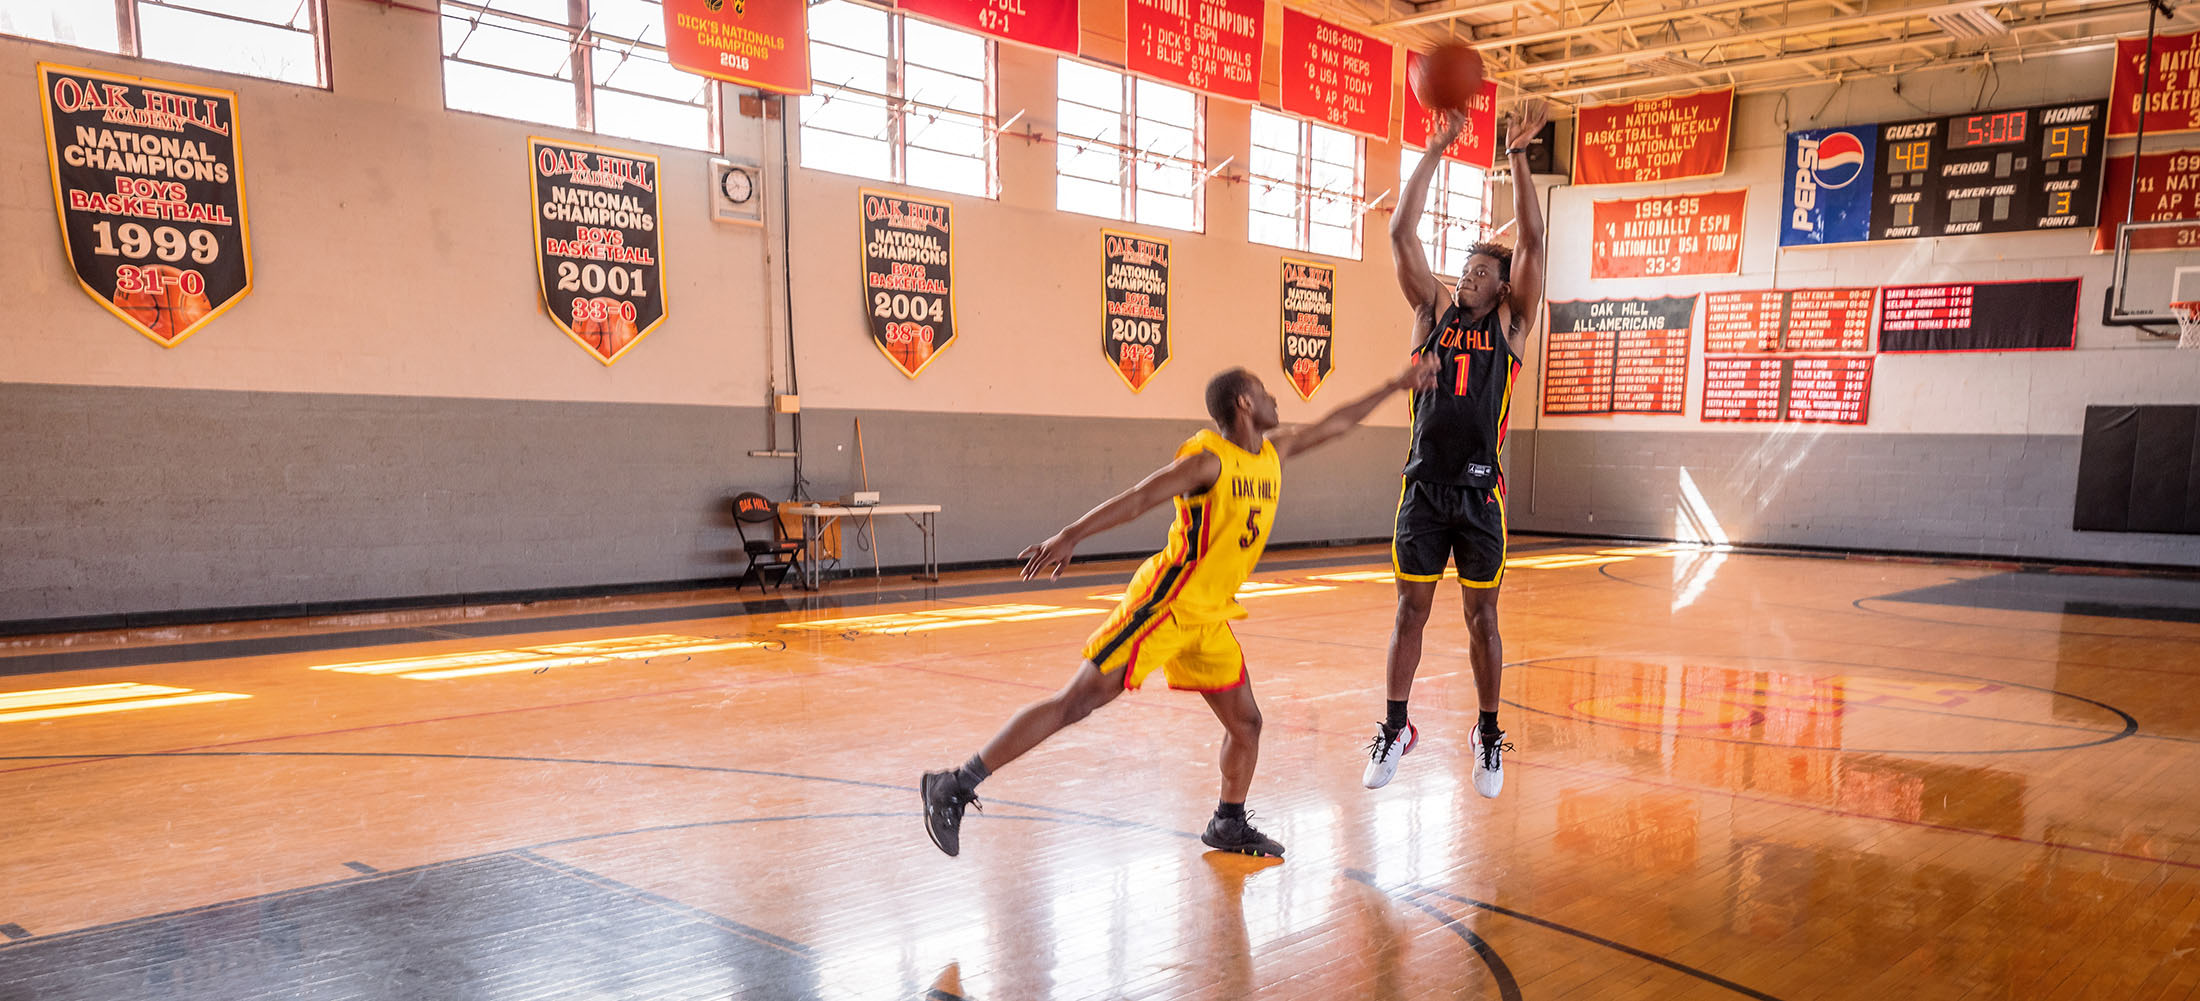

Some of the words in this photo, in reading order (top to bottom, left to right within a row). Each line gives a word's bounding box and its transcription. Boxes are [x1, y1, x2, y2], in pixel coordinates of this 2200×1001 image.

[677, 13, 719, 34] DICK'S
[722, 24, 785, 50] NATIONALS
[979, 8, 1009, 33] 47-1
[1200, 3, 1255, 38] CHAMPIONS
[1194, 23, 1218, 44] ESPN
[1316, 24, 1363, 54] 2016-2017
[698, 32, 769, 60] CHAMPIONS
[1158, 28, 1191, 52] DICK'S
[1198, 41, 1251, 68] NATIONALS
[720, 52, 749, 71] 2016
[1157, 45, 1184, 66] BLUE
[1191, 55, 1217, 75] STAR
[1223, 64, 1252, 82] MEDIA
[1321, 48, 1339, 68] MAX
[1343, 54, 1370, 77] PREPS
[1188, 71, 1209, 88] 45-1
[1320, 67, 1338, 87] USA
[1344, 75, 1373, 96] TODAY
[55, 77, 134, 113] OAK
[142, 90, 229, 136] HILL
[1325, 90, 1338, 104] AP
[1343, 94, 1366, 114] POLL
[103, 109, 188, 133] ACADEMY
[1327, 106, 1349, 125] 38-5
[1625, 105, 1699, 128] NATIONALLY
[2043, 105, 2095, 124] HOME
[1584, 126, 1663, 146] BASKETBALL
[1671, 116, 1721, 137] WEEKLY
[1886, 123, 1937, 140] GUEST
[1968, 111, 2027, 145] 5:00
[76, 125, 216, 163] NATIONAL
[1625, 135, 1698, 156] NATIONALLY
[2050, 126, 2089, 157] 97
[64, 144, 230, 184] CHAMPIONS
[1615, 156, 1639, 170] USA
[1647, 150, 1683, 167] TODAY
[1896, 141, 1928, 170] 48
[539, 148, 592, 178] OAK
[596, 155, 653, 193] HILL
[569, 170, 626, 190] ACADEMY
[1635, 168, 1661, 182] 27-1
[1942, 161, 1990, 177] PERIOD
[115, 176, 187, 202] BOYS
[1792, 139, 1819, 231] PEPSI
[2045, 180, 2079, 192] FOULS
[69, 189, 232, 226] BASKETBALL
[551, 186, 644, 215] NATIONAL
[1635, 197, 1700, 220] 1994-95
[1890, 192, 1921, 204] FOULS
[2056, 191, 2071, 214] 3
[2158, 193, 2183, 210] AP
[542, 202, 655, 231] CHAMPIONS
[866, 196, 903, 222] OAK
[907, 202, 949, 234] HILL
[1907, 203, 1914, 225] 1
[2039, 215, 2077, 228] POINTS
[576, 226, 624, 247] BOYS
[1624, 217, 1691, 239] NATIONALLY
[1699, 214, 1731, 233] ESPN
[1885, 226, 1919, 238] POINTS
[1945, 222, 1981, 234] MATCH
[92, 220, 220, 265] 1999
[546, 238, 655, 266] BASKETBALL
[874, 228, 942, 254] NATIONAL
[1107, 236, 1135, 259] OAK
[1137, 240, 1168, 269] HILL
[1612, 238, 1671, 257] NATIONALLY
[1679, 236, 1699, 254] USA
[1706, 233, 1738, 252] TODAY
[868, 242, 948, 266] CHAMPIONS
[1645, 255, 1681, 274] 33-3
[116, 264, 206, 296] 31-0
[557, 261, 648, 298] 2001
[891, 261, 926, 280] BOYS
[1111, 263, 1162, 283] NATIONAL
[1285, 263, 1308, 284] OAK
[1309, 267, 1332, 290] HILL
[869, 271, 949, 296] BASKETBALL
[1106, 275, 1167, 296] CHAMPIONS
[1288, 287, 1327, 304] NATIONAL
[1887, 289, 1905, 300] DAVID
[571, 297, 638, 323] 33-0
[874, 291, 945, 323] 2004
[1125, 291, 1150, 305] BOYS
[1284, 298, 1332, 316] CHAMPIONS
[1591, 303, 1614, 317] OAK
[1621, 303, 1649, 317] HILL
[1915, 298, 1946, 309] JOHNSON
[1107, 300, 1165, 321] BASKETBALL
[1904, 308, 1934, 319] ANTHONY
[885, 322, 935, 345] 38-0
[1111, 318, 1162, 345] 2005
[1573, 316, 1665, 333] ALL-AMERICANS
[1884, 319, 1915, 331] CAMERON
[1917, 318, 1944, 329] THOMAS
[1287, 335, 1327, 359] 2007
[1454, 353, 1471, 396] 1
[739, 498, 754, 513] OAK
[753, 498, 771, 512] HILL
[1239, 507, 1261, 549] 5
